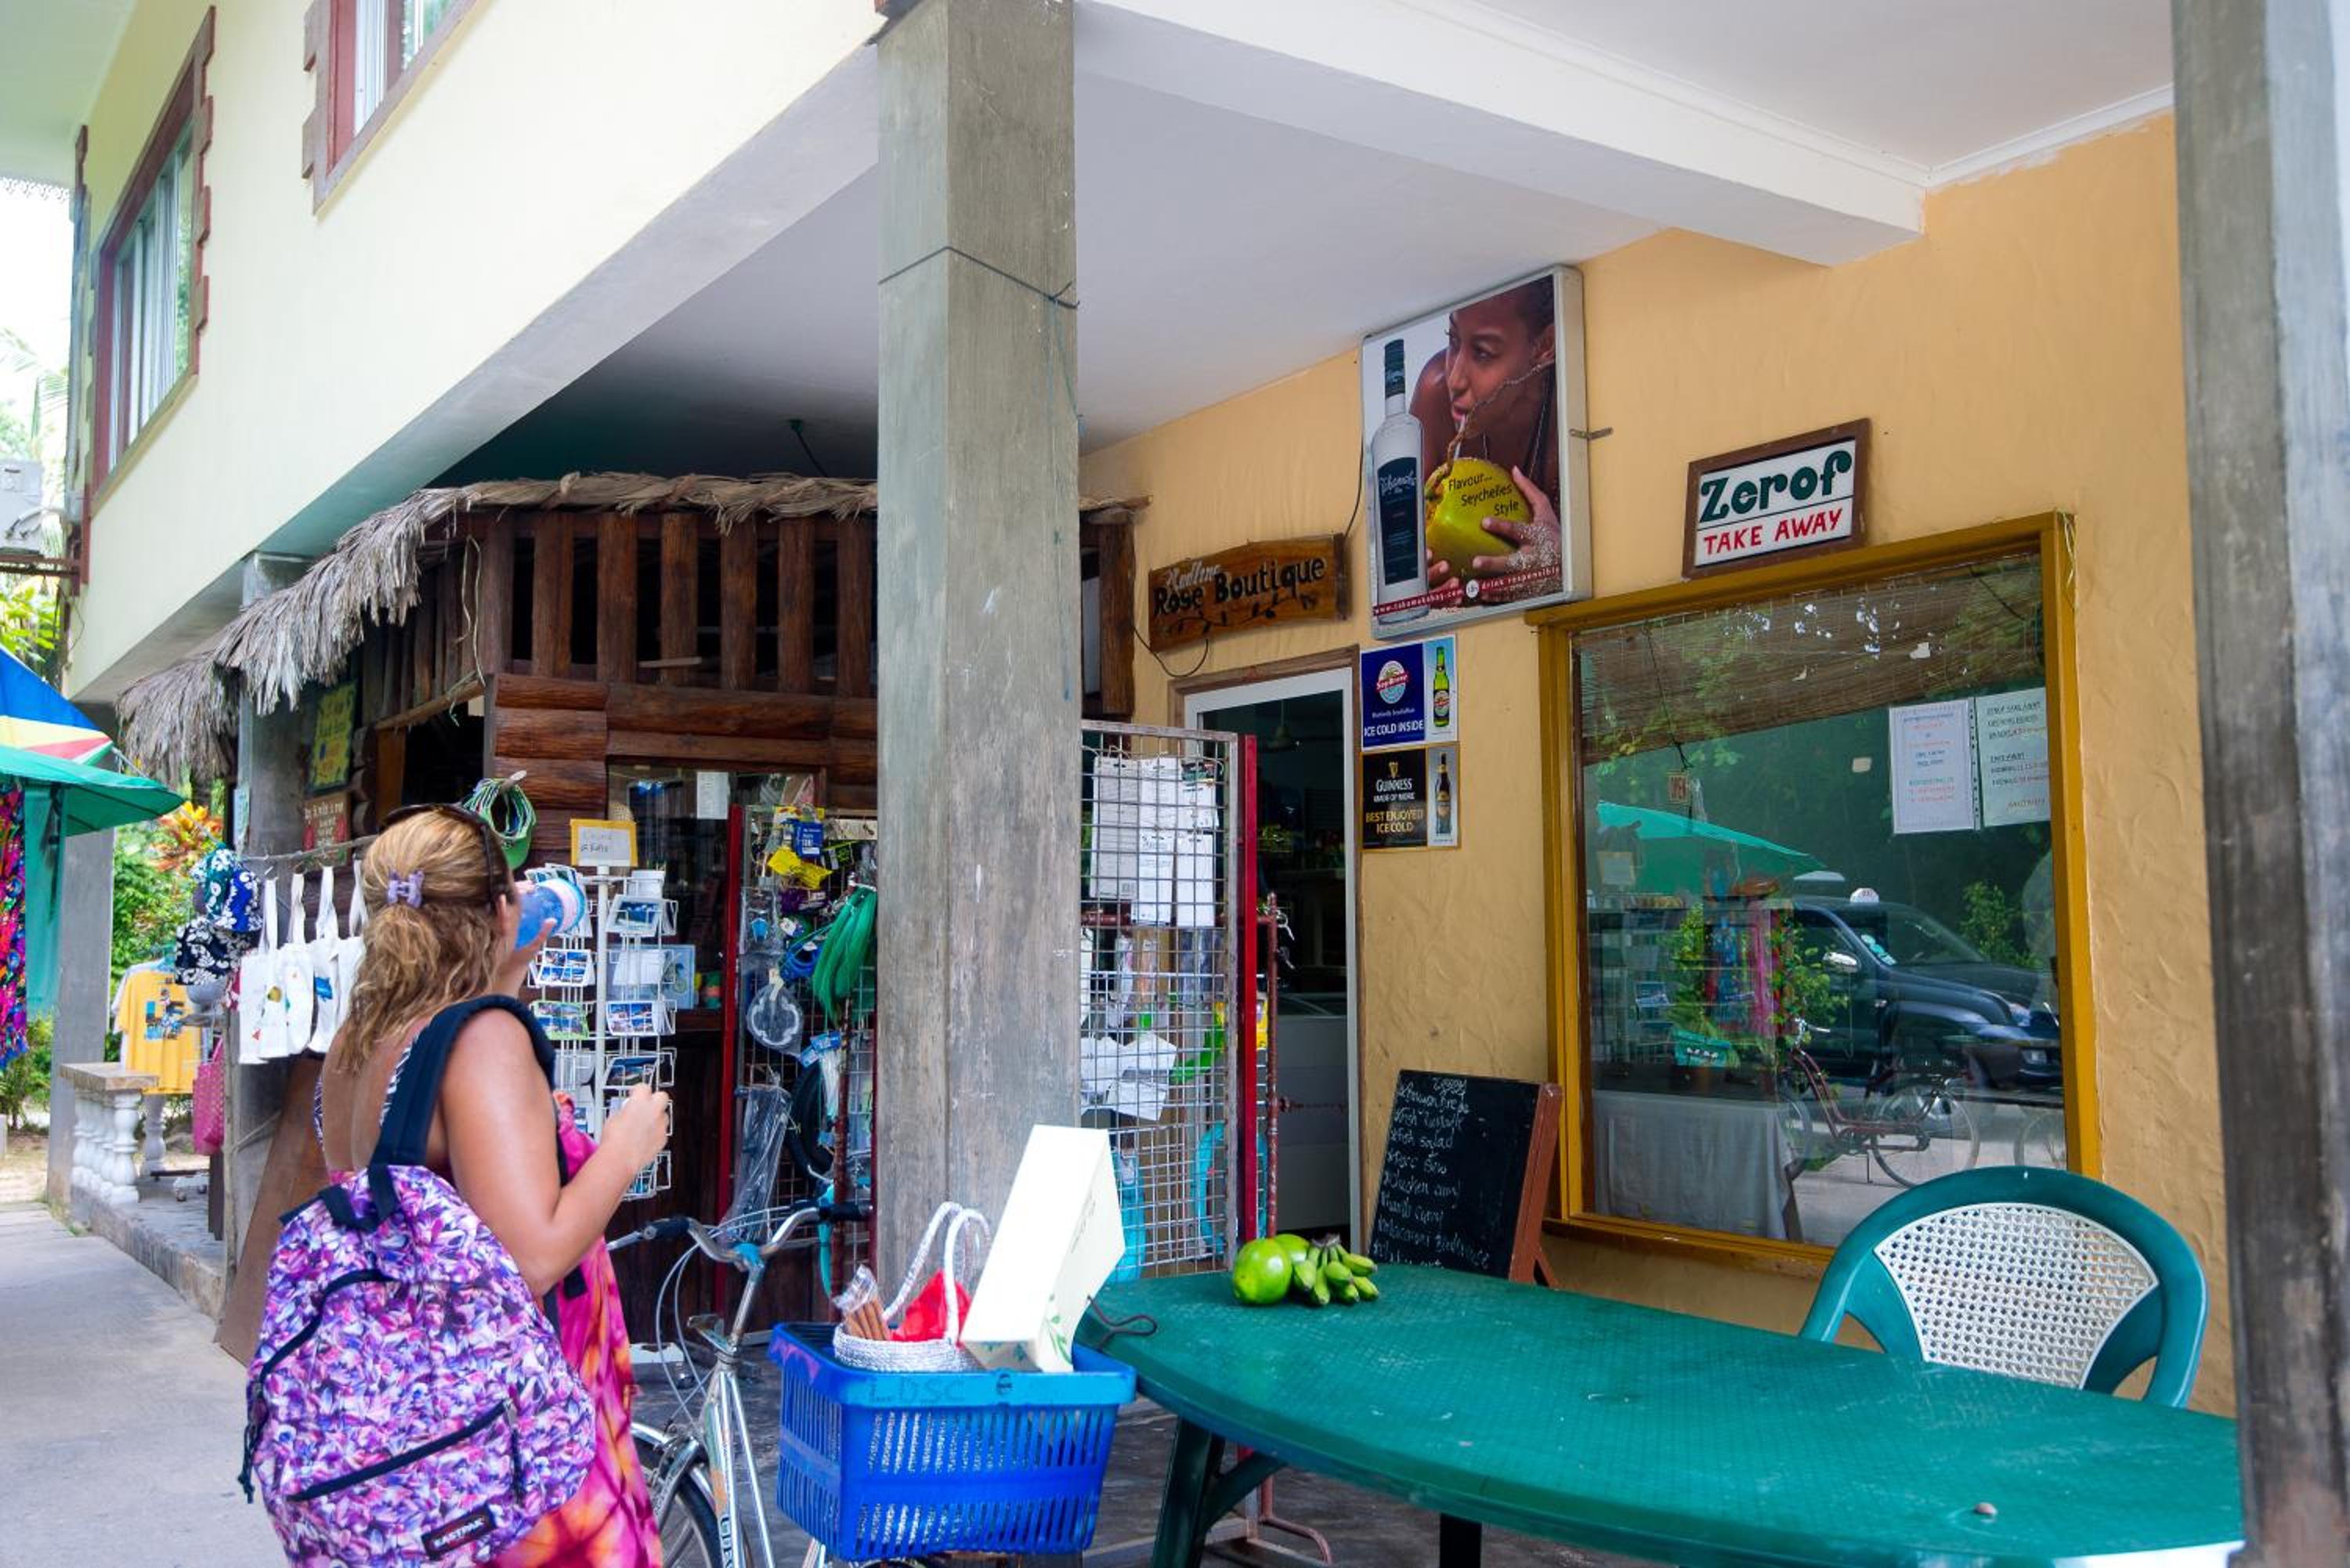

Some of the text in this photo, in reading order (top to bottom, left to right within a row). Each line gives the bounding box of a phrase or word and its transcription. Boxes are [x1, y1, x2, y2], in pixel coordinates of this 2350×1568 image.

[1461, 483, 1513, 507] Seychelles
[1699, 450, 1853, 523] Zerof
[1494, 500, 1520, 516] Style
[1704, 508, 1843, 555] TAKE AWAY
[1153, 556, 1326, 617] Rose Boutique
[1364, 720, 1424, 737] ICE COLD INSIDE
[1376, 778, 1412, 793] GUINNESS
[1365, 809, 1424, 823] BEST ENJOYED
[1376, 822, 1415, 835] ICE COLD
